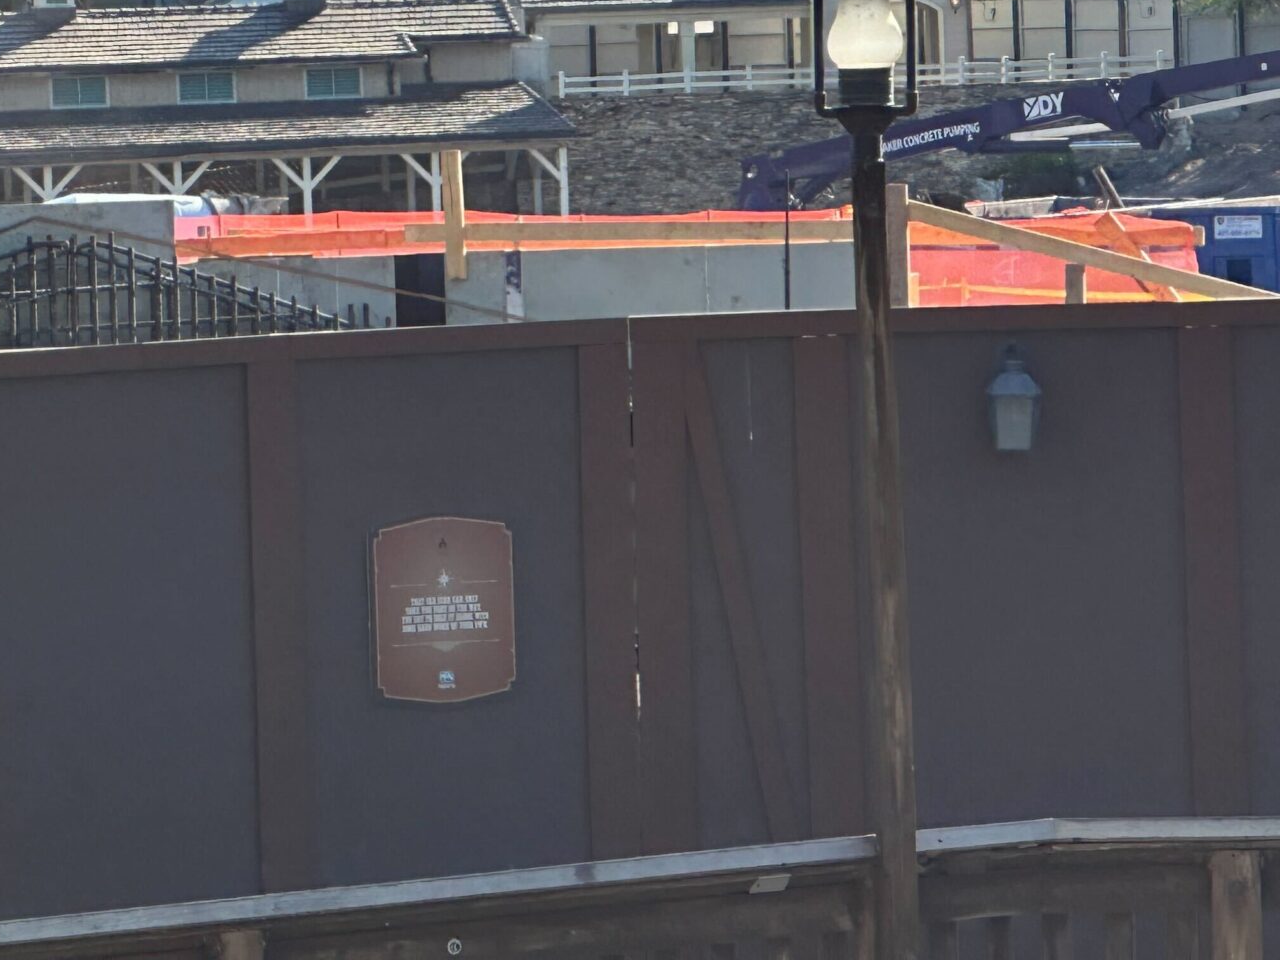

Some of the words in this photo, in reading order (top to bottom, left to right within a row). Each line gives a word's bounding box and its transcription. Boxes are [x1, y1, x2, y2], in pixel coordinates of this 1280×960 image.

[881, 138, 903, 153] AKER
[903, 128, 943, 148] CONCRETE
[943, 121, 981, 139] PUMPING
